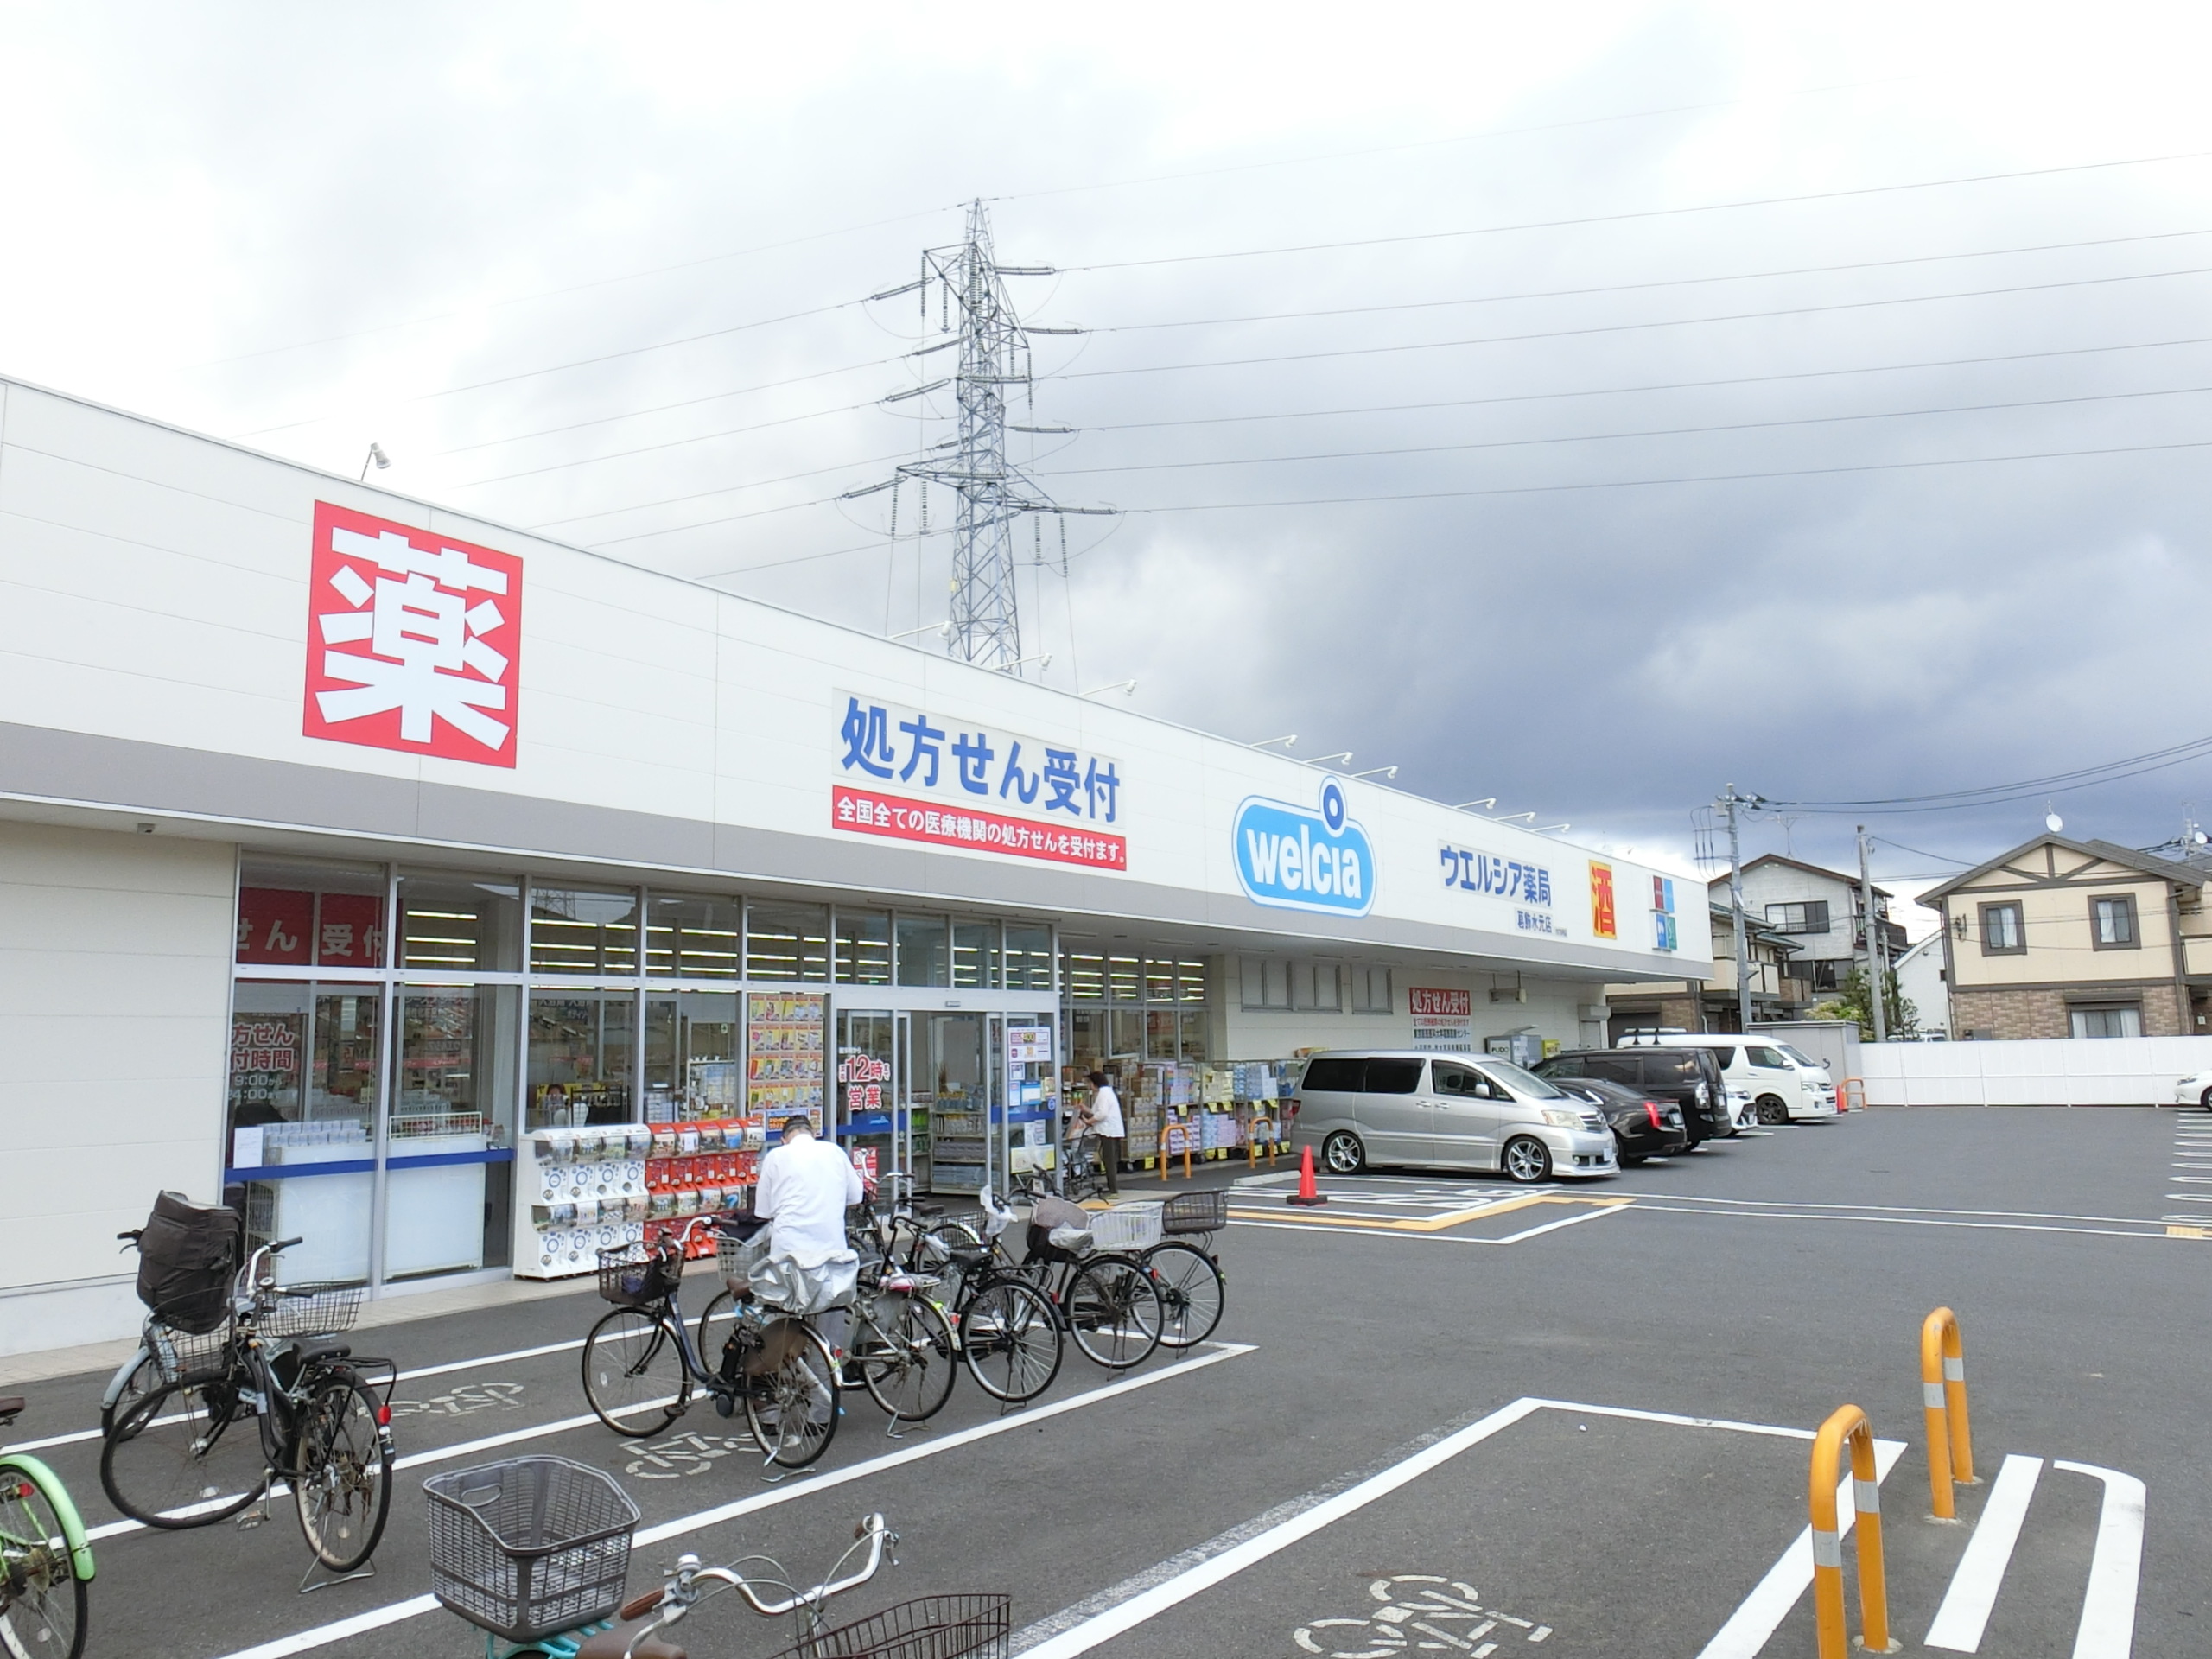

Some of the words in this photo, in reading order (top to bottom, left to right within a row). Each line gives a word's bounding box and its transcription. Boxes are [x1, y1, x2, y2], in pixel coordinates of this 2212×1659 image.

[315, 525, 511, 752] 薬
[841, 696, 1121, 823] 処方せん受付
[1245, 783, 1363, 900] welcia
[1440, 844, 1552, 908] ウエルシア薬局
[1591, 865, 1616, 936] 酒
[1411, 988, 1469, 1014] 処方せん受付
[848, 1084, 882, 1110] 営業
